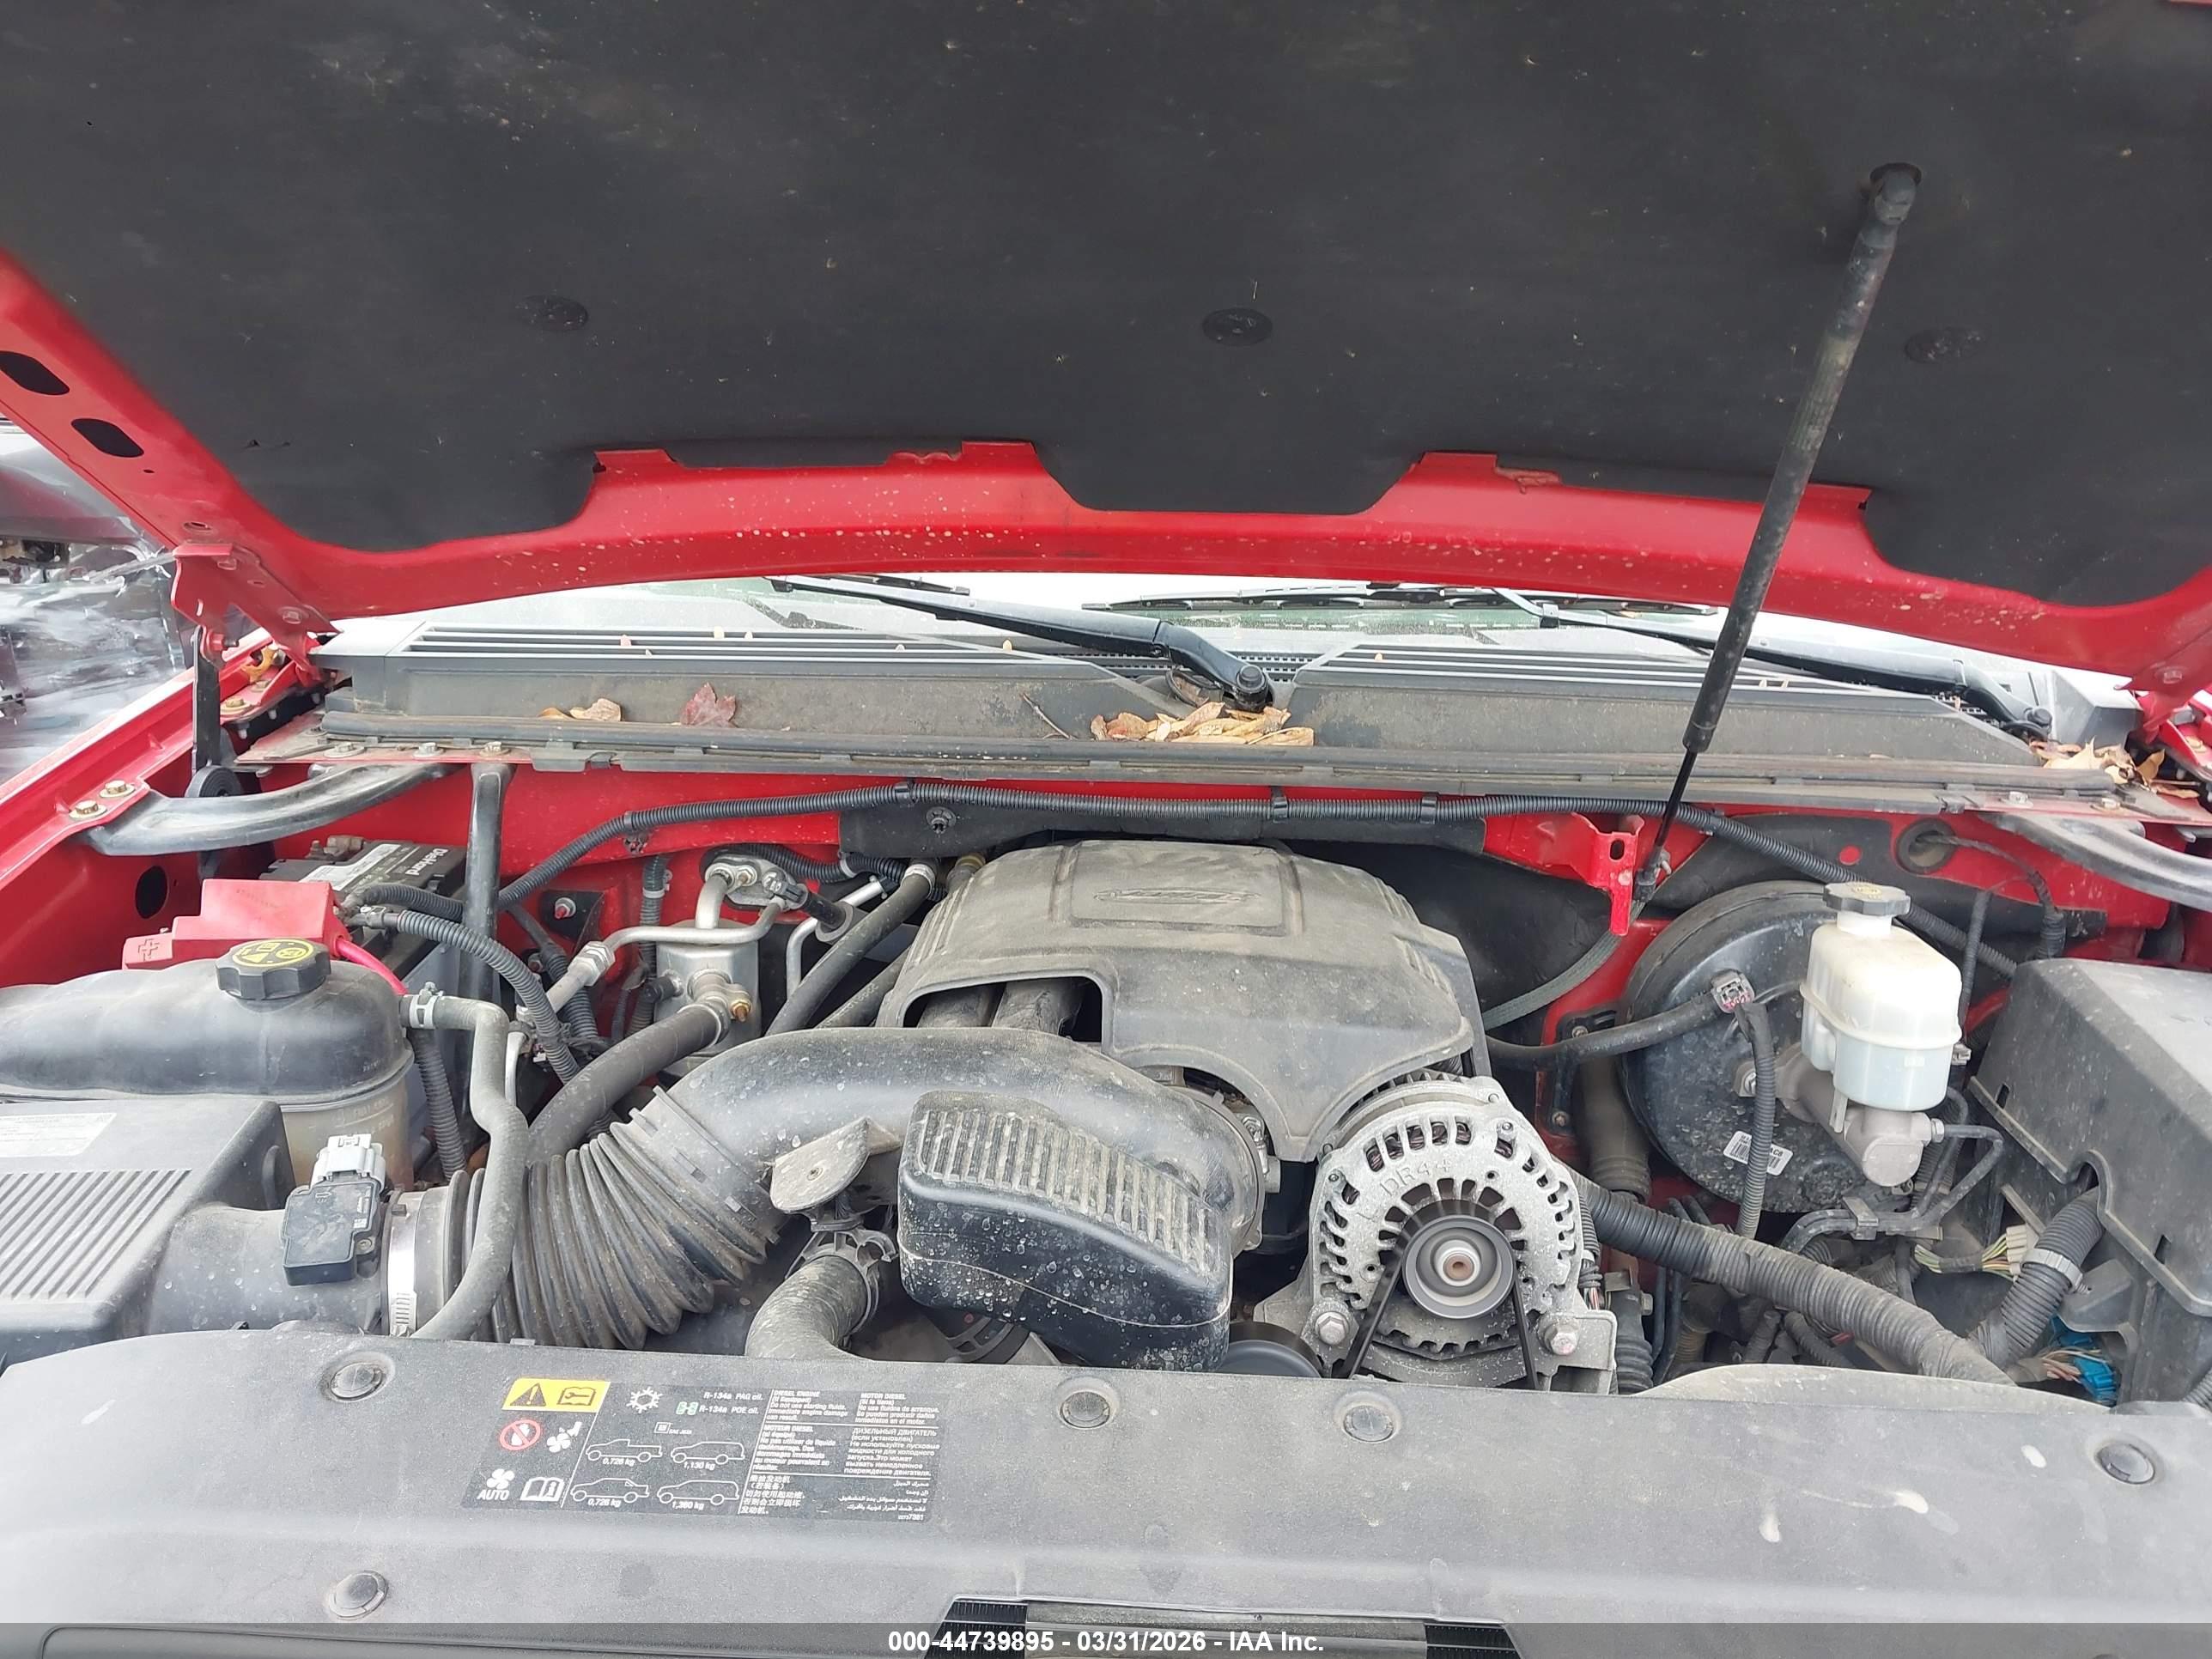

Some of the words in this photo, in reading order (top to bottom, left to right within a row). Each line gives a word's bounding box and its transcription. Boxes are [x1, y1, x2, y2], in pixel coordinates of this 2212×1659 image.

[699, 1405, 727, 1413] R-134a
[625, 1458, 635, 1467] kg
[477, 1490, 509, 1501] AUTO
[611, 1499, 621, 1508] kg
[694, 1502, 704, 1510] kg
